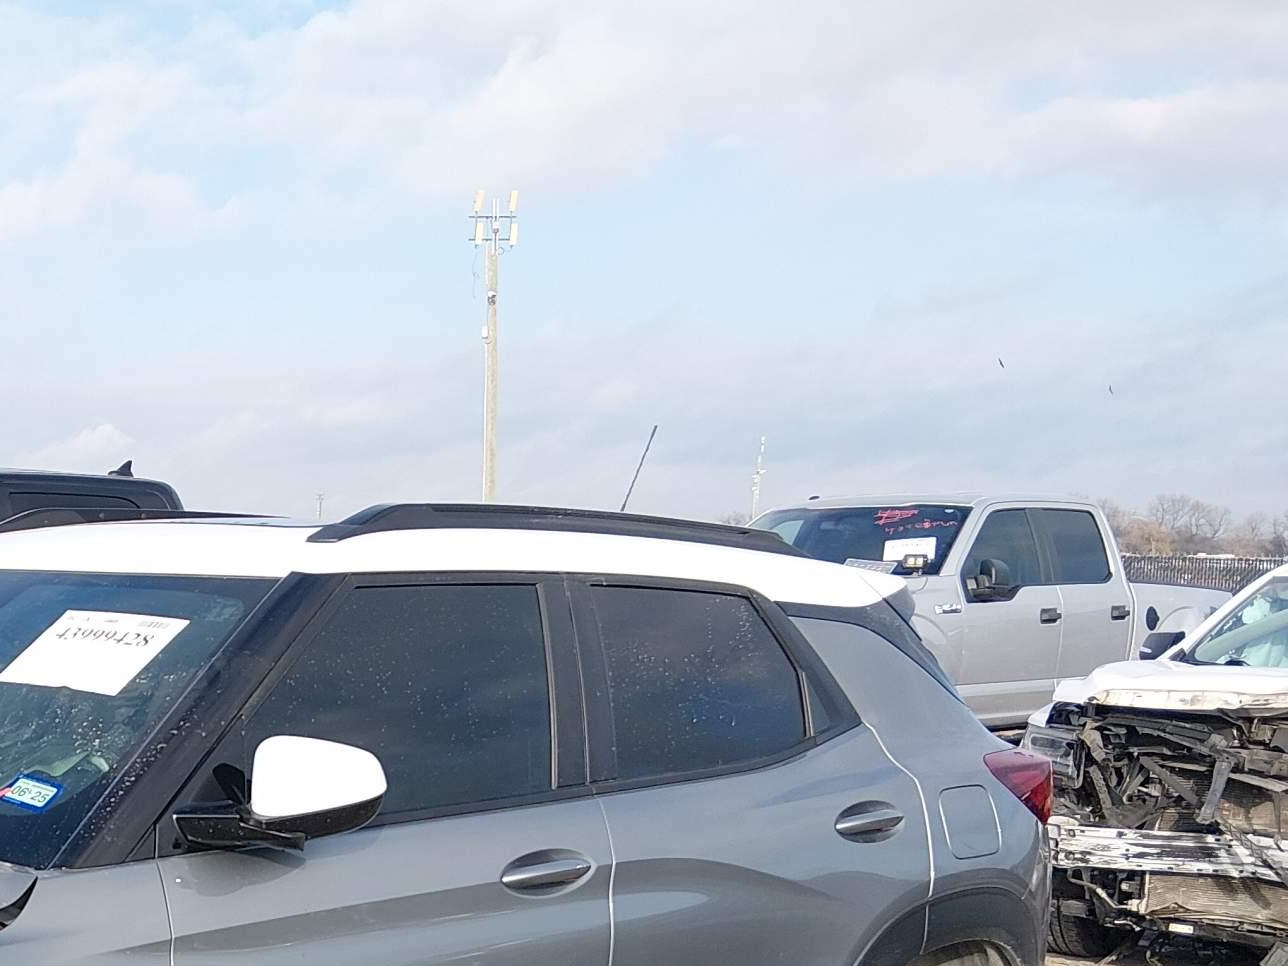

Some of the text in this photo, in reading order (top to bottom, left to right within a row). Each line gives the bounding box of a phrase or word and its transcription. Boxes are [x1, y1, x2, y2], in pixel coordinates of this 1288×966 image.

[56, 626, 155, 647] 43999428
[11, 785, 29, 797] 06
[30, 790, 51, 804] 25
